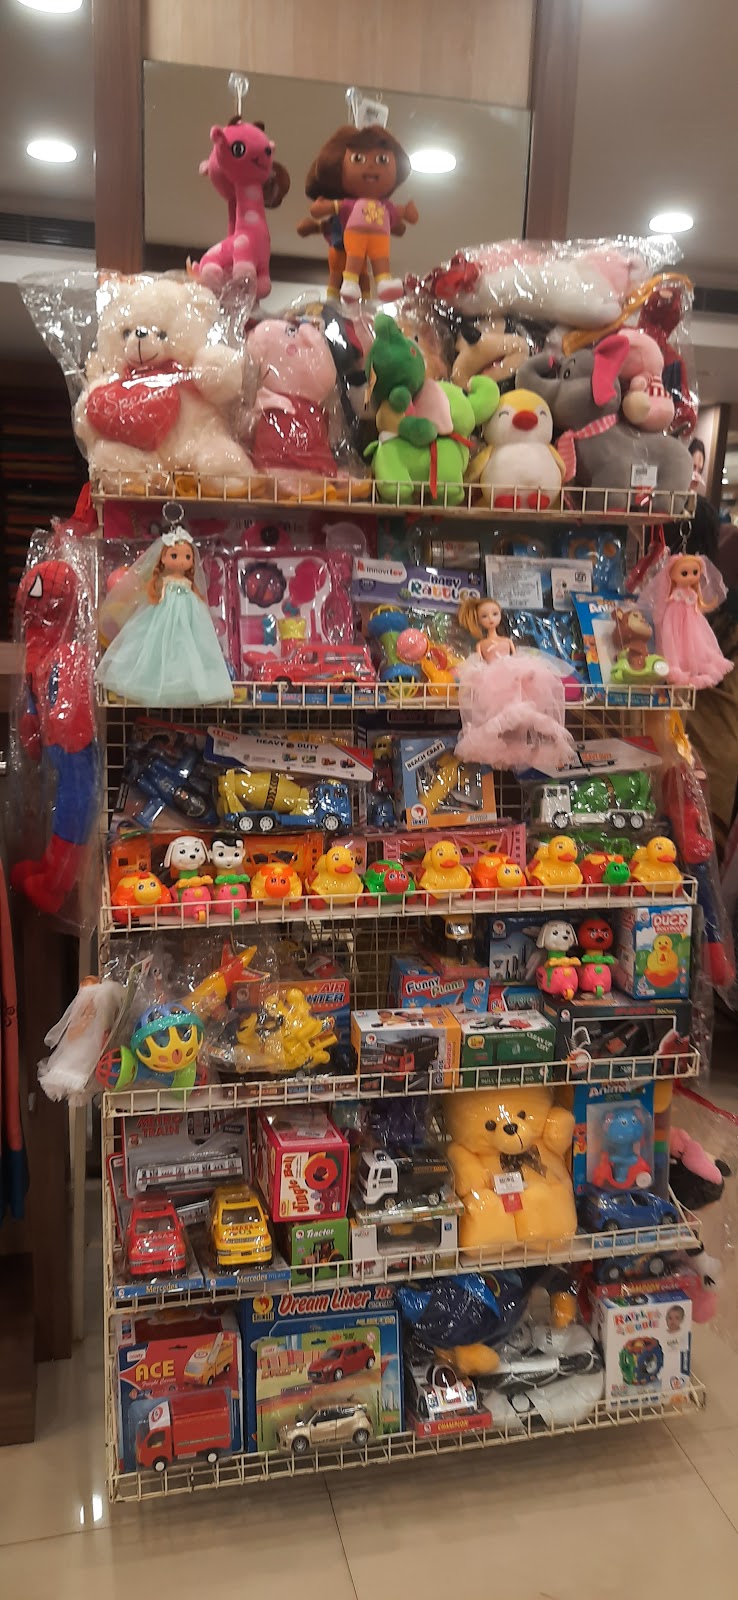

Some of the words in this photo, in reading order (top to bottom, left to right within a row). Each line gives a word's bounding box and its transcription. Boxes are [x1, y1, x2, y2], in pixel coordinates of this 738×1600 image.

[256, 738, 284, 747] HEAVY
[297, 742, 319, 750] DUTY
[406, 752, 427, 768] BEACH
[425, 742, 444, 758] CRAFT
[652, 912, 689, 927] DUCK
[319, 982, 346, 993] AIR
[136, 1114, 185, 1129] METRO
[142, 1124, 180, 1138] TRAIN
[289, 1179, 310, 1213] Jingle
[306, 1228, 335, 1239] Tractor
[236, 1272, 268, 1284] Mercedes
[145, 1282, 178, 1295] Mercedes
[277, 1292, 330, 1317] Dream
[330, 1287, 372, 1312] Liner
[135, 1359, 175, 1383] ACE
